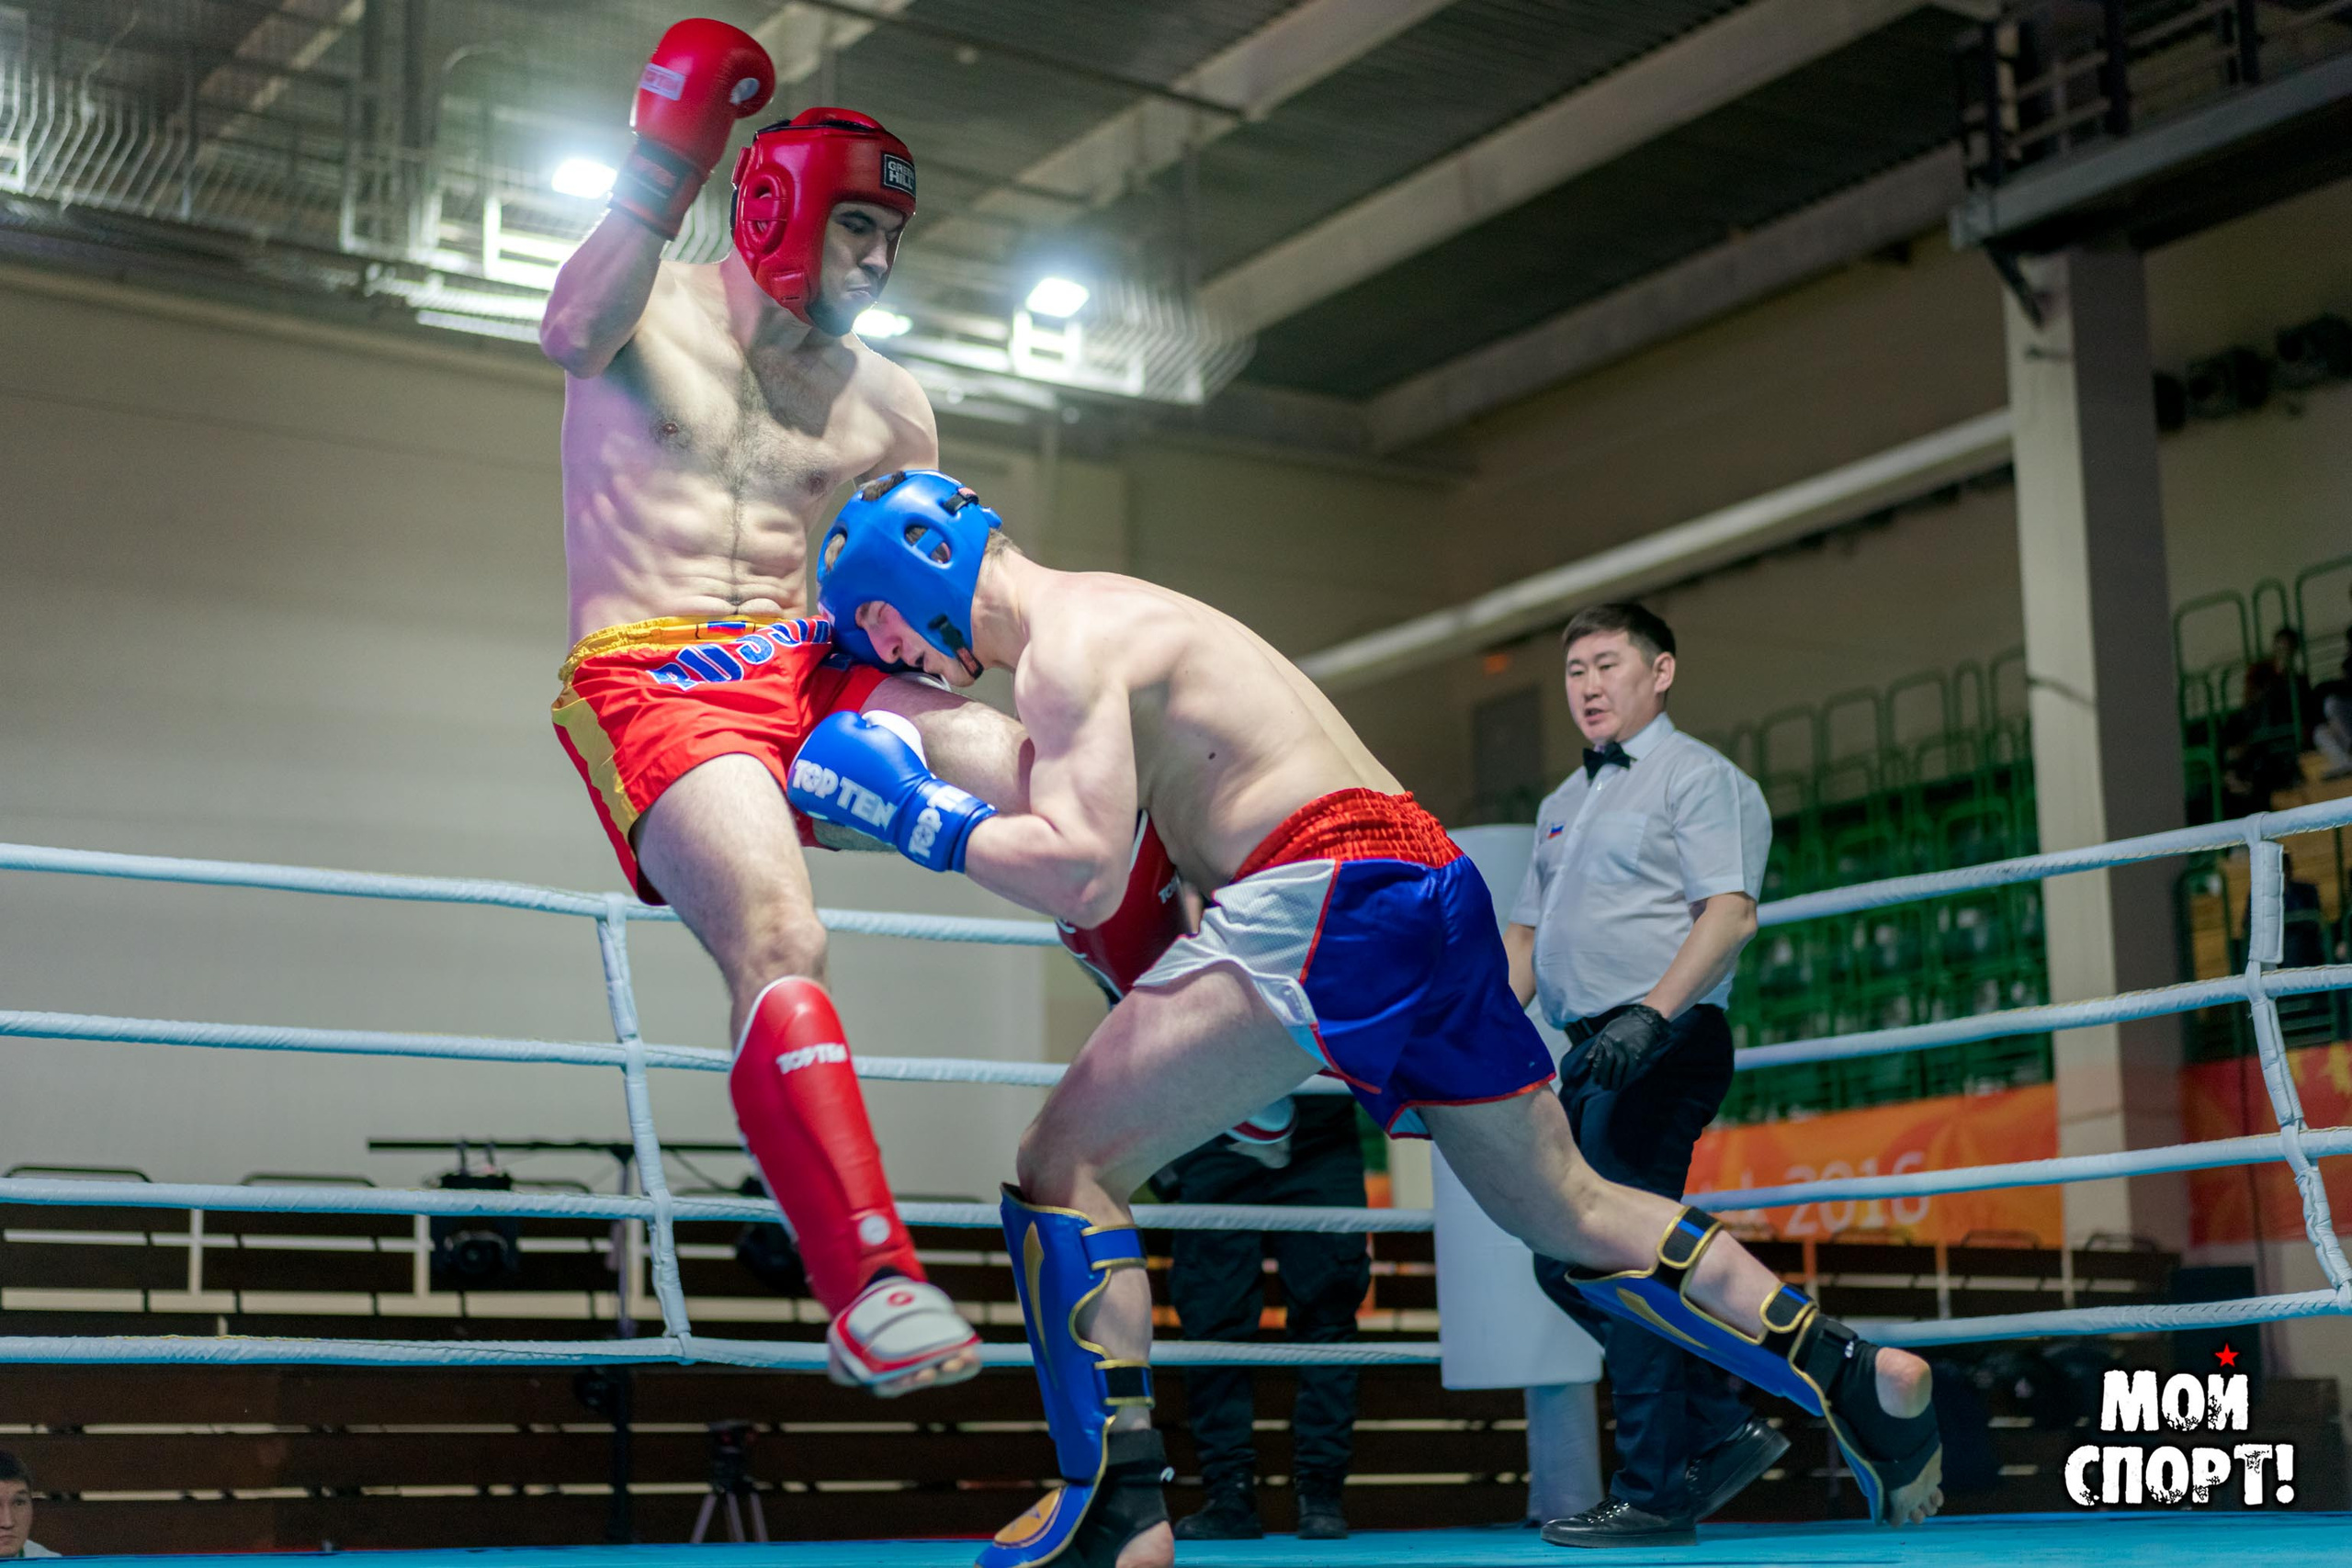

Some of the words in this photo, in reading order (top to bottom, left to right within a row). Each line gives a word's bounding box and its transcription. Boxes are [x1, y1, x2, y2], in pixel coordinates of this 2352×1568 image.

[792, 759, 839, 799] TOP
[837, 776, 898, 831] TEN
[908, 807, 944, 859] TOP
[1785, 1151, 1948, 1236] 2016
